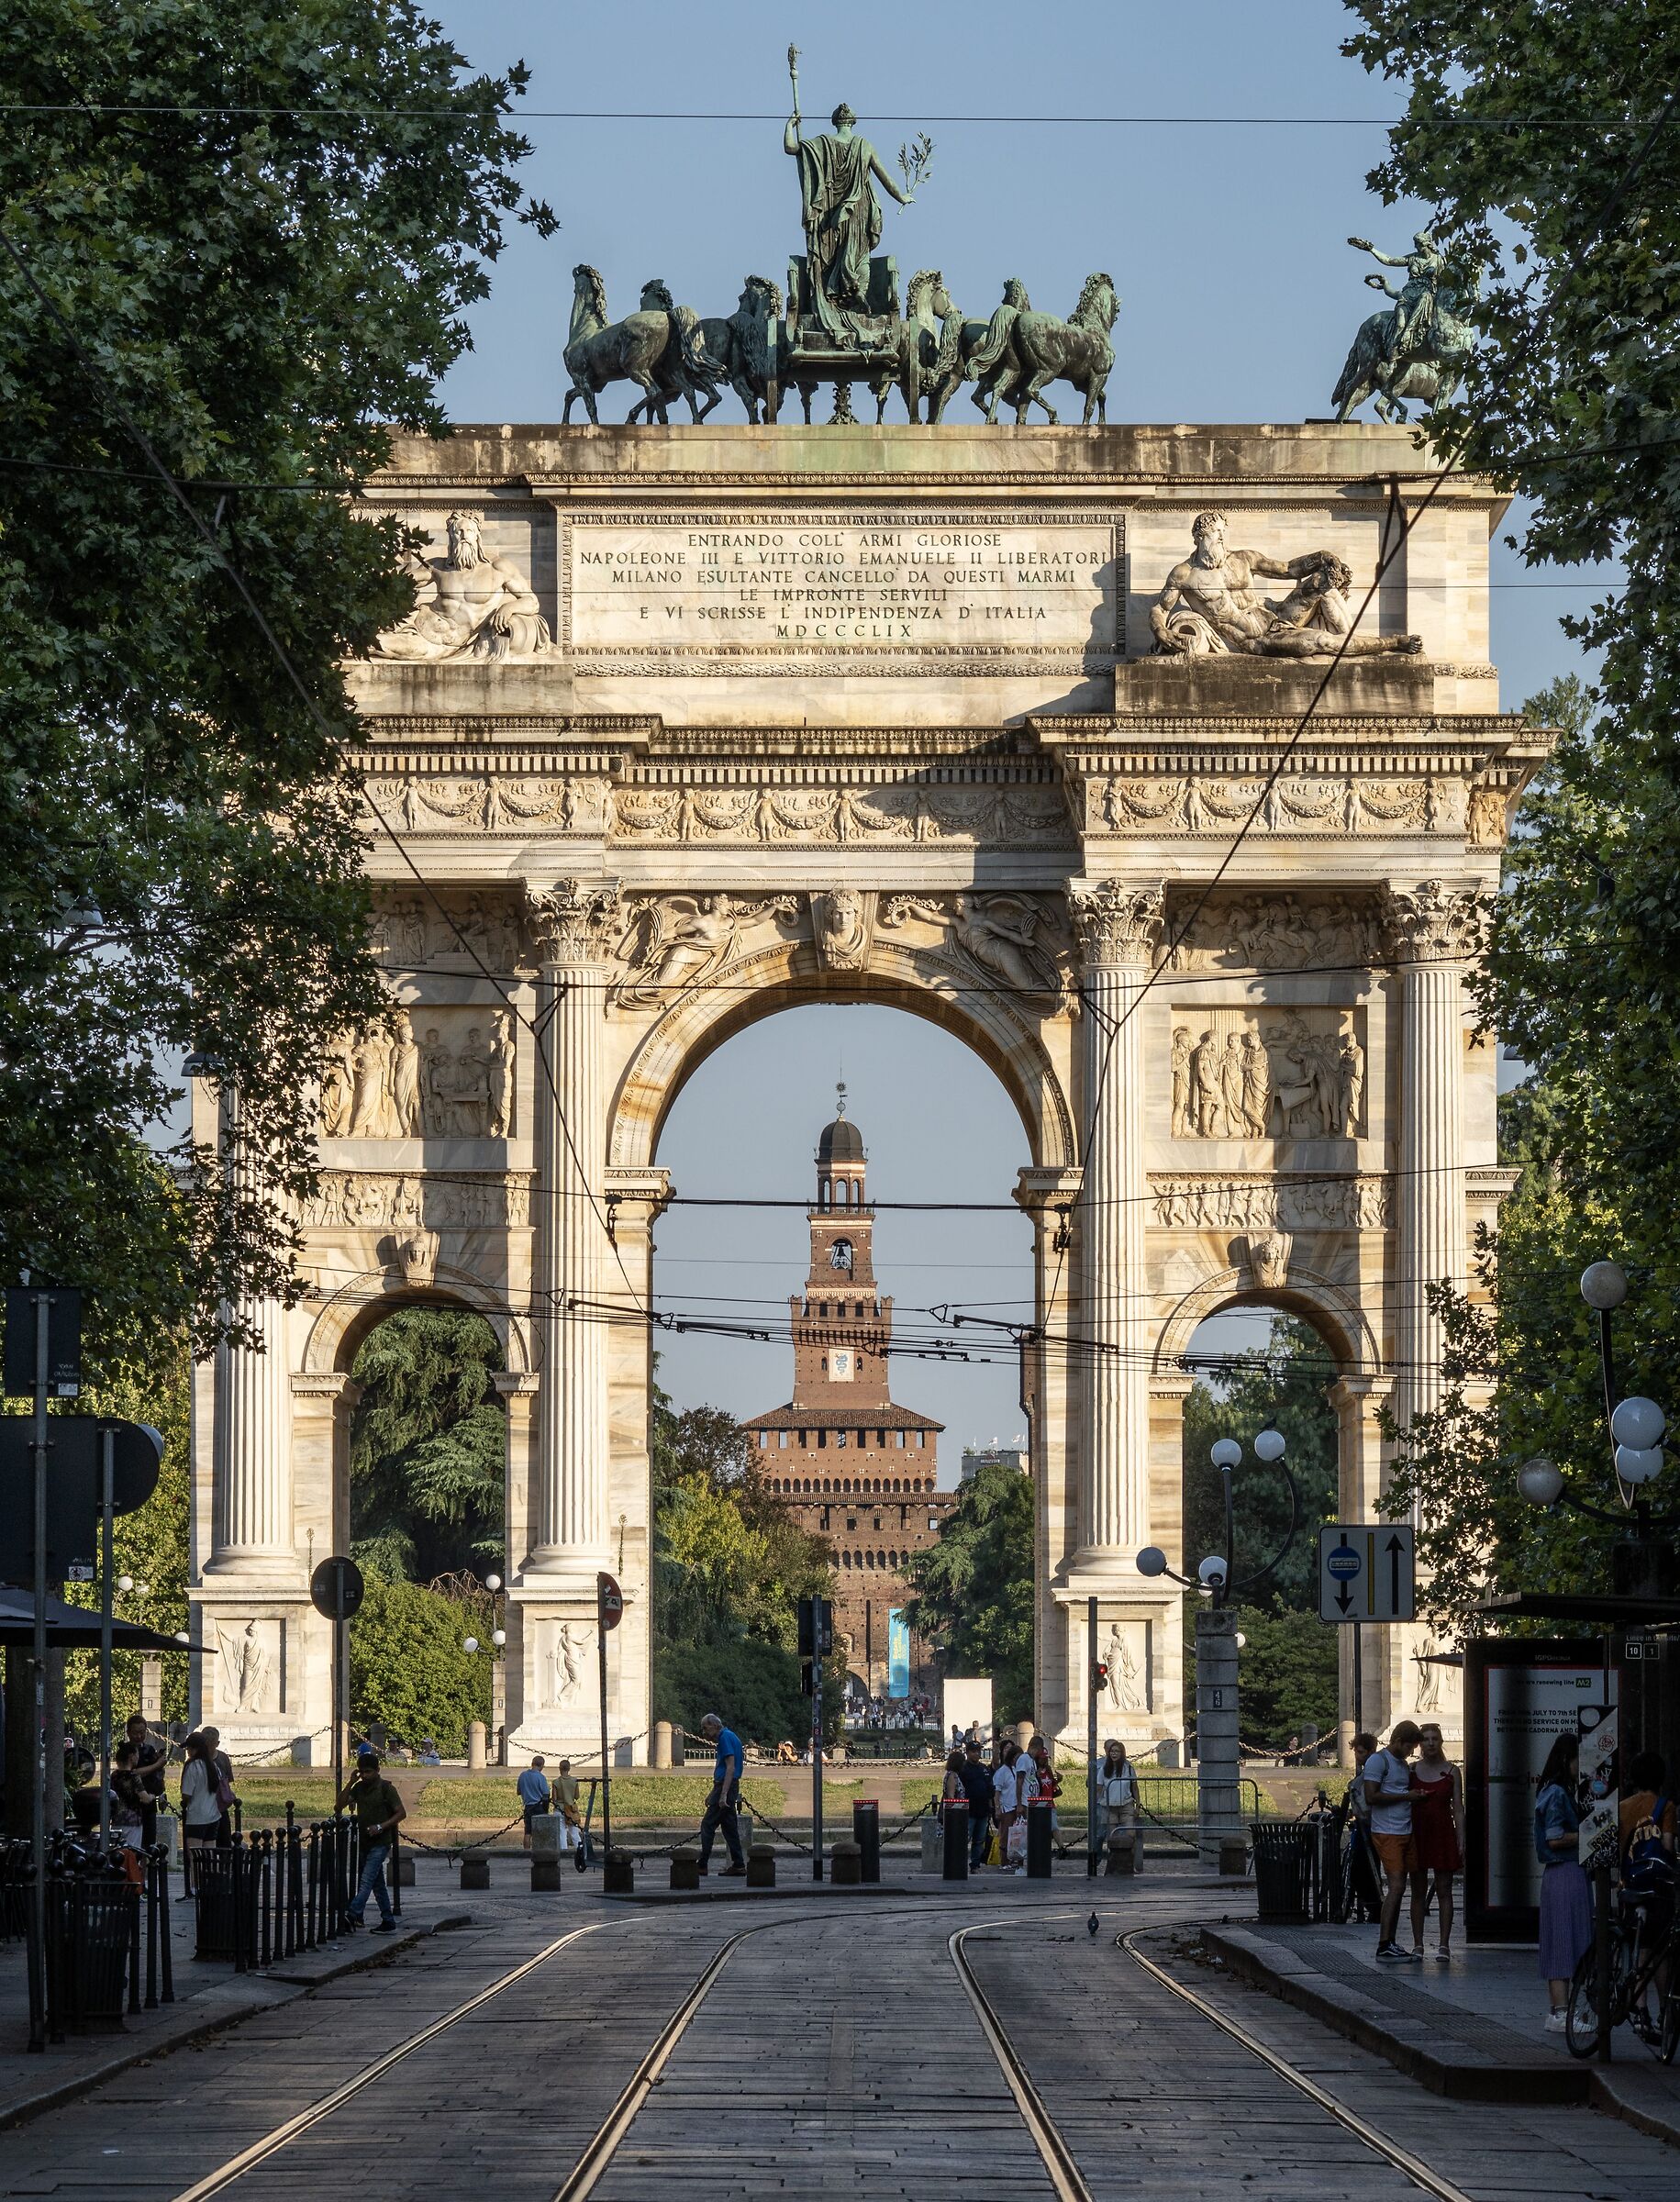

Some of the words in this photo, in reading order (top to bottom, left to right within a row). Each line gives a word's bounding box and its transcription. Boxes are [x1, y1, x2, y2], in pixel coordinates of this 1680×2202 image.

[688, 534, 784, 547] ENTRANDO
[859, 534, 902, 547] ARMI
[918, 534, 1002, 547] GLORIOSE
[580, 552, 686, 564] NAPOLEONE
[701, 552, 718, 564] III
[734, 552, 743, 564] E
[759, 552, 844, 564] VITTORIO
[859, 552, 956, 564] EMANUELE
[971, 552, 983, 564] II
[997, 552, 1107, 564] LIBERATORI
[612, 571, 683, 583] MILANO
[696, 571, 793, 583] ESULTANTE
[907, 571, 930, 583] DA
[943, 571, 1005, 584] QUESTI
[1018, 571, 1075, 583] MARMI
[740, 589, 758, 601] LE
[773, 589, 865, 601] IMPRONTE
[880, 589, 948, 601] SERVILI
[639, 606, 649, 619] E
[665, 606, 684, 619] VI
[697, 606, 766, 619] SCRISSE
[805, 606, 941, 619] INDIPENDENZA
[985, 606, 1047, 619] ITALIA
[1630, 1647, 1639, 1655] 10
[1576, 1678, 1591, 1687] M2
